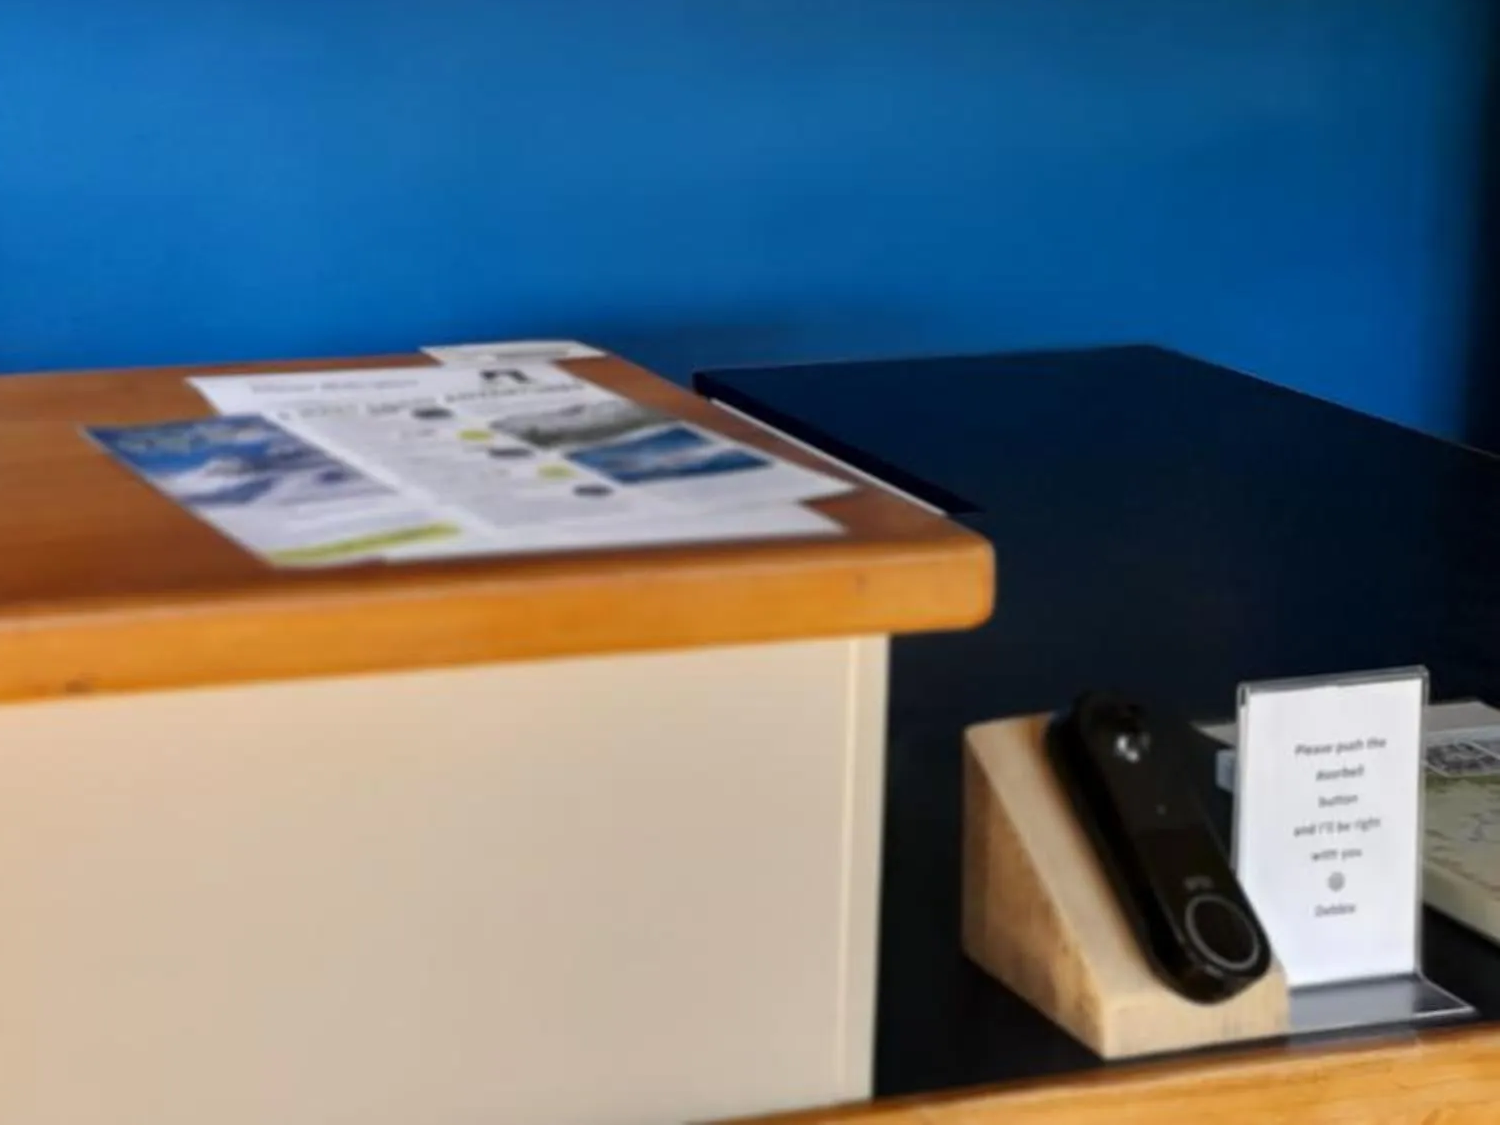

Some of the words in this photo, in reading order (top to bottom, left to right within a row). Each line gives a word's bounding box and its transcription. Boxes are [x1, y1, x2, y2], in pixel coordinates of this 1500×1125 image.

[1294, 742, 1333, 756] Please
[1335, 739, 1364, 756] push
[1366, 737, 1387, 750] the
[1317, 793, 1359, 809] button
[1293, 822, 1317, 837] and
[1353, 817, 1381, 834] right
[1340, 847, 1363, 862] you
